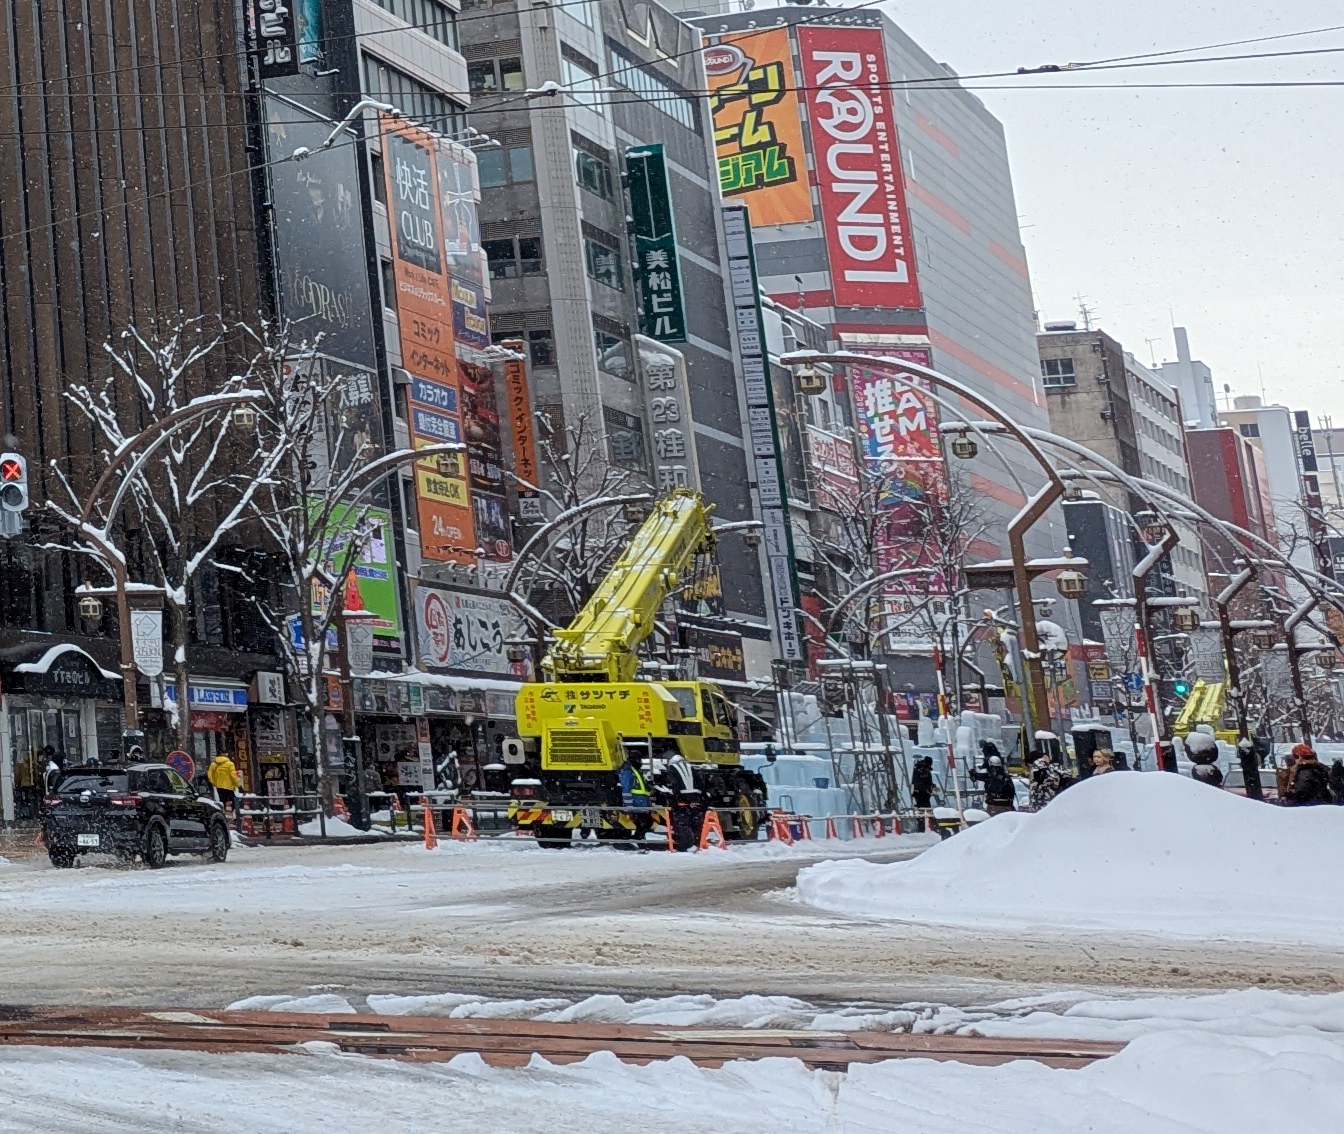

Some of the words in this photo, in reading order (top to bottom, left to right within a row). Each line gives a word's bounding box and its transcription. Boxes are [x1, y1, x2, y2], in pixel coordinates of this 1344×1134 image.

[865, 53, 885, 115] SPORTS
[875, 121, 906, 257] ENTERTAINMENT
[395, 155, 431, 211] 快活
[401, 209, 435, 250] CLUB
[645, 249, 679, 337] 美松ビル
[413, 318, 441, 346] コミック
[418, 381, 450, 408] カラオケ
